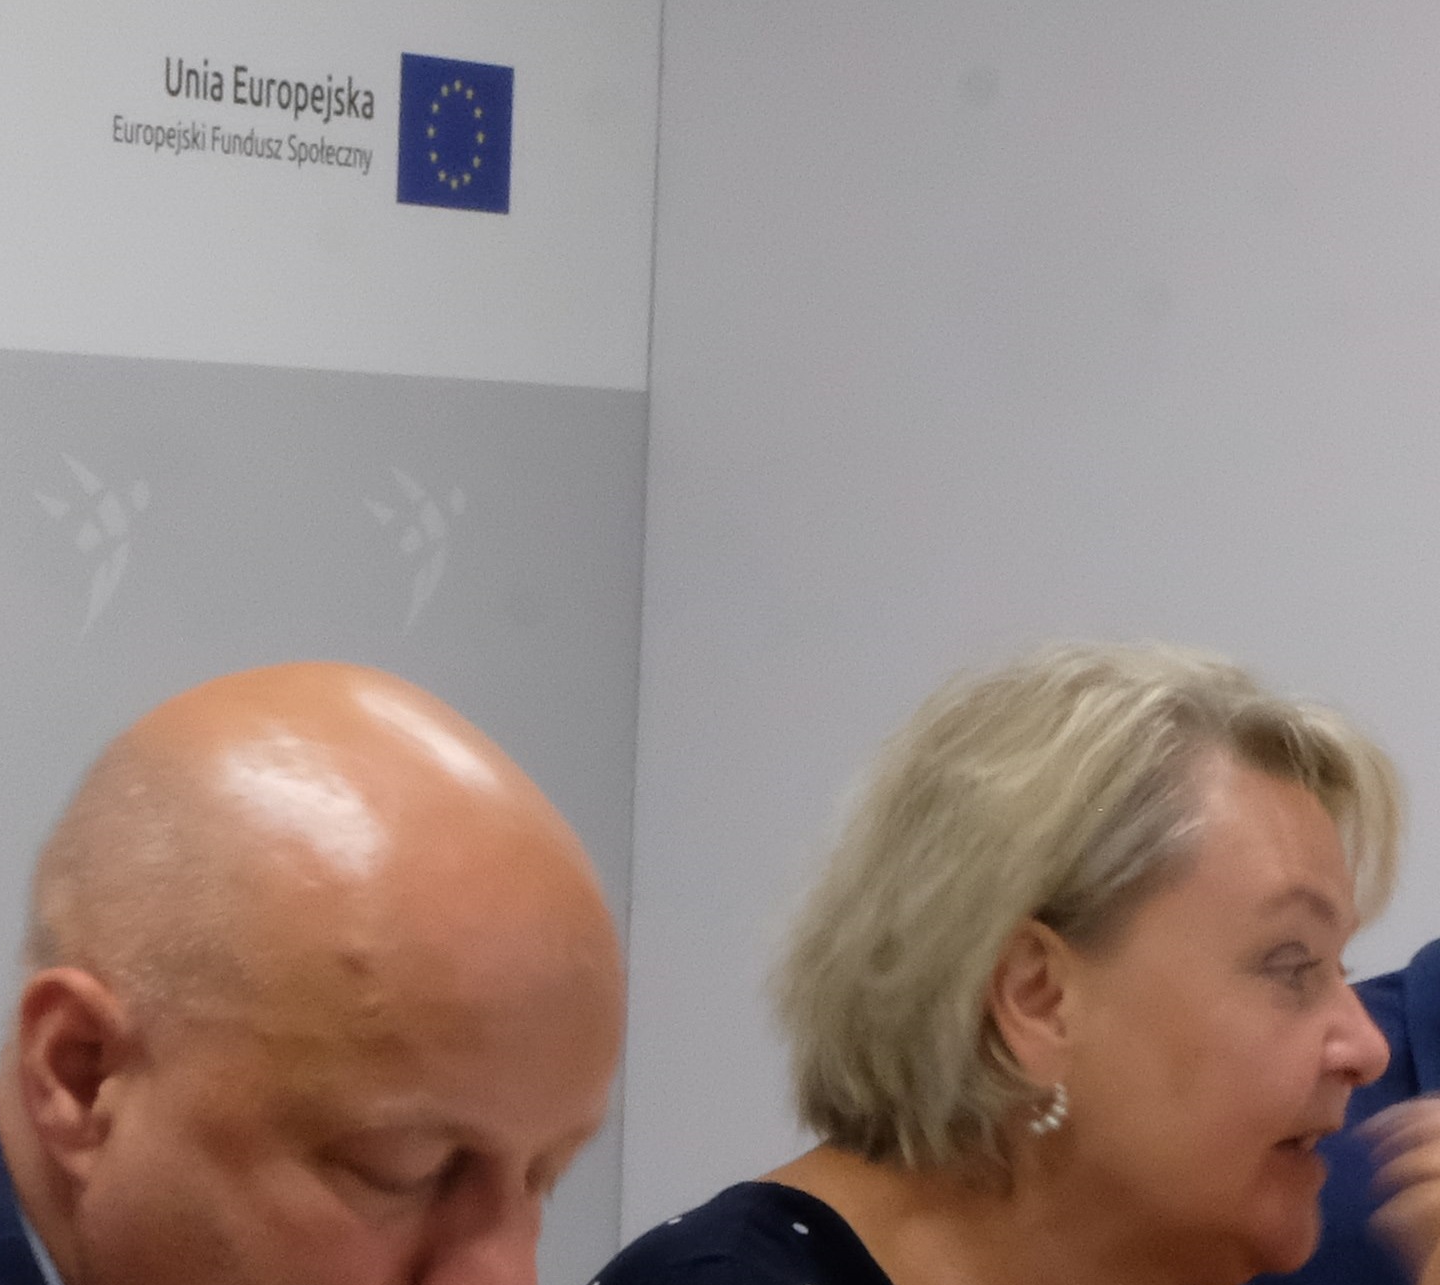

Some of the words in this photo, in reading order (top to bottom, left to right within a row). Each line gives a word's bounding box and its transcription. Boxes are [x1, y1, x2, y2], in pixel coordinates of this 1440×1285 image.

[165, 56, 223, 102] Unia
[233, 65, 375, 124] Europejska
[112, 115, 206, 157] Europejski
[211, 126, 282, 162] Fundusz
[288, 134, 374, 176] Społeczny
